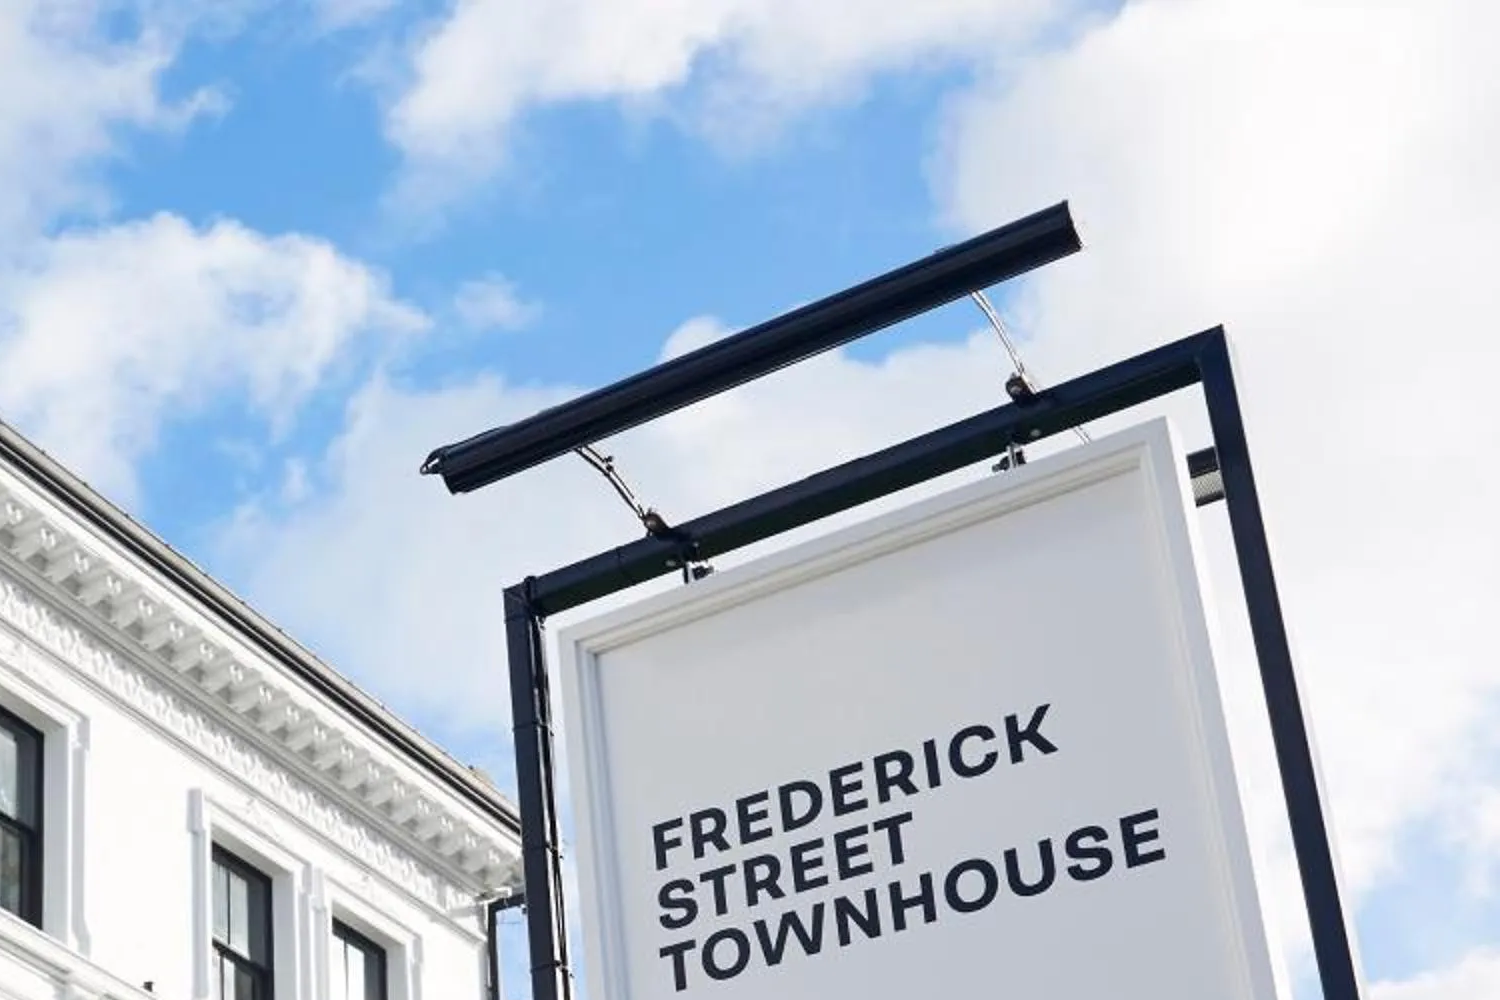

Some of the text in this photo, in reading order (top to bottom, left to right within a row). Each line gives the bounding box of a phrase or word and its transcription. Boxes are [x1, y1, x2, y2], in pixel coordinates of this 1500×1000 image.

[652, 704, 1058, 870] FREDERICK
[657, 812, 914, 930] STREET
[659, 808, 1167, 992] TOWNHOUSE
